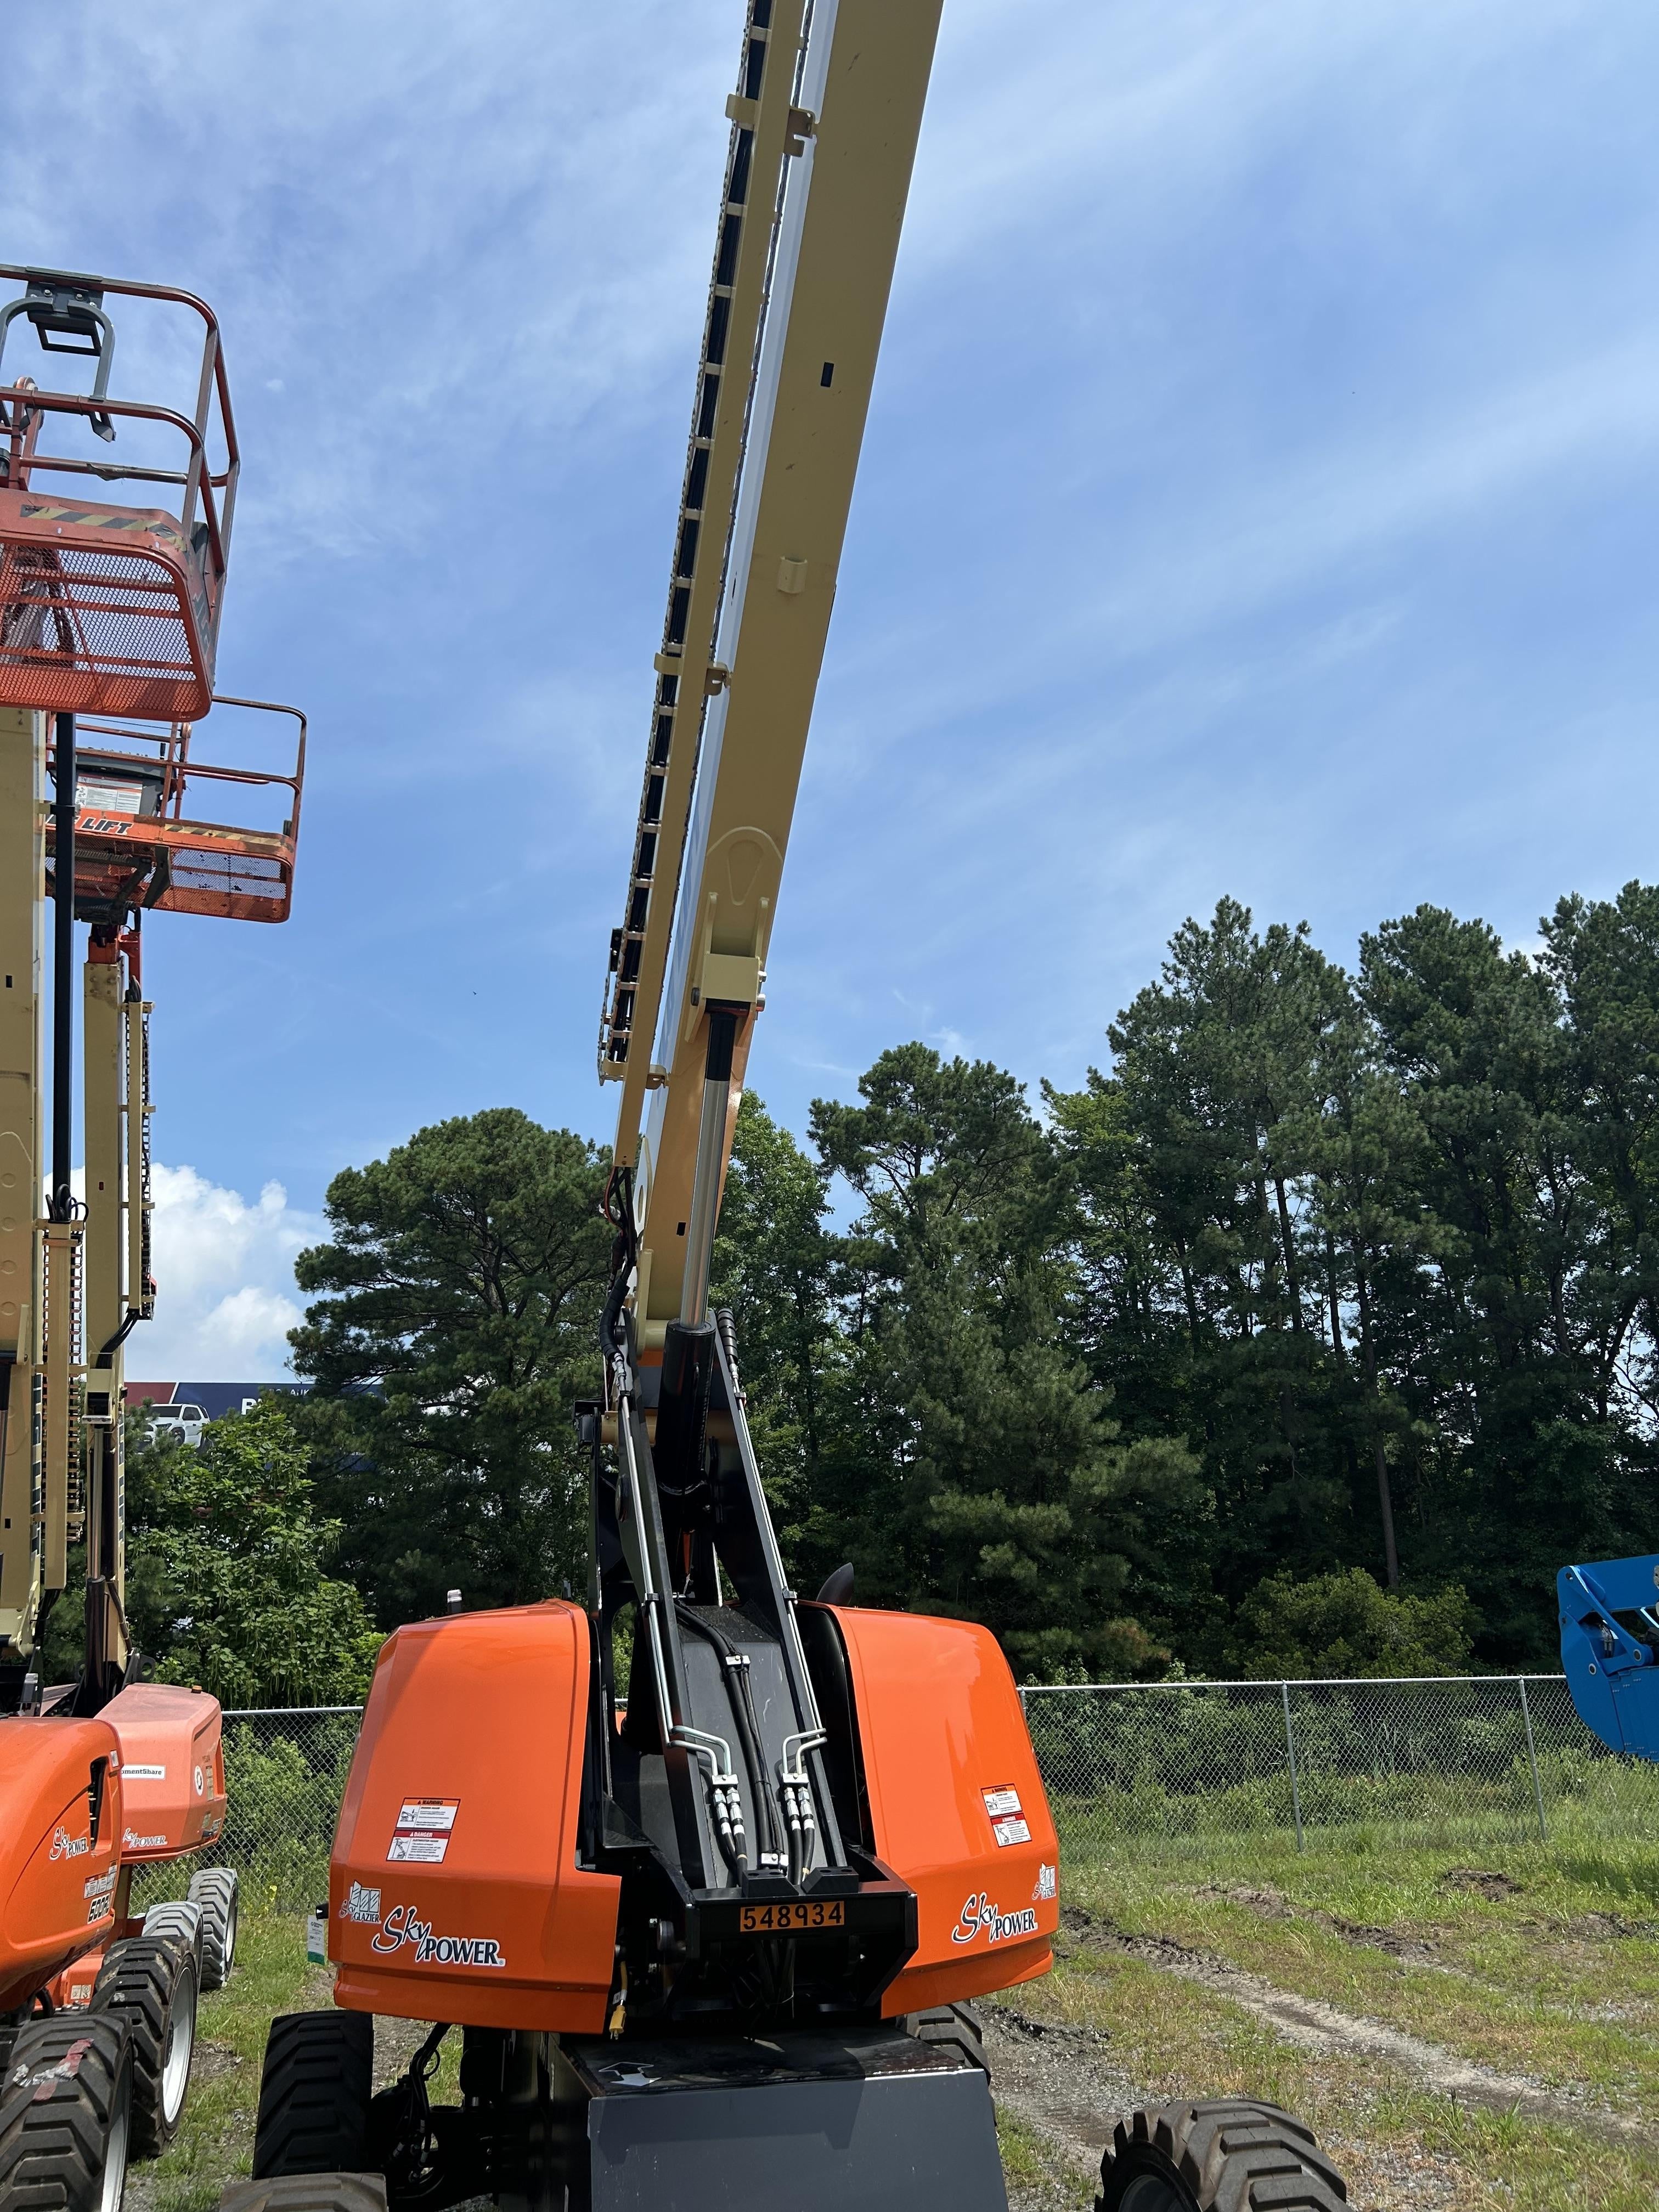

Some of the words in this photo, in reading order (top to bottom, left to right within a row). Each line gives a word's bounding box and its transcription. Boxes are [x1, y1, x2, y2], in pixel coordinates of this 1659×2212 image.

[81, 817, 134, 835] LIFT
[67, 1837, 89, 1859] POWER
[133, 1836, 167, 1848] POWER
[353, 1912, 380, 1923] GLAZIER
[743, 1902, 842, 1930] 548934
[952, 1892, 997, 1943] Sky
[994, 1909, 1035, 1939] POWER
[372, 1906, 432, 1962] Sky
[424, 1937, 498, 1965] POWER
